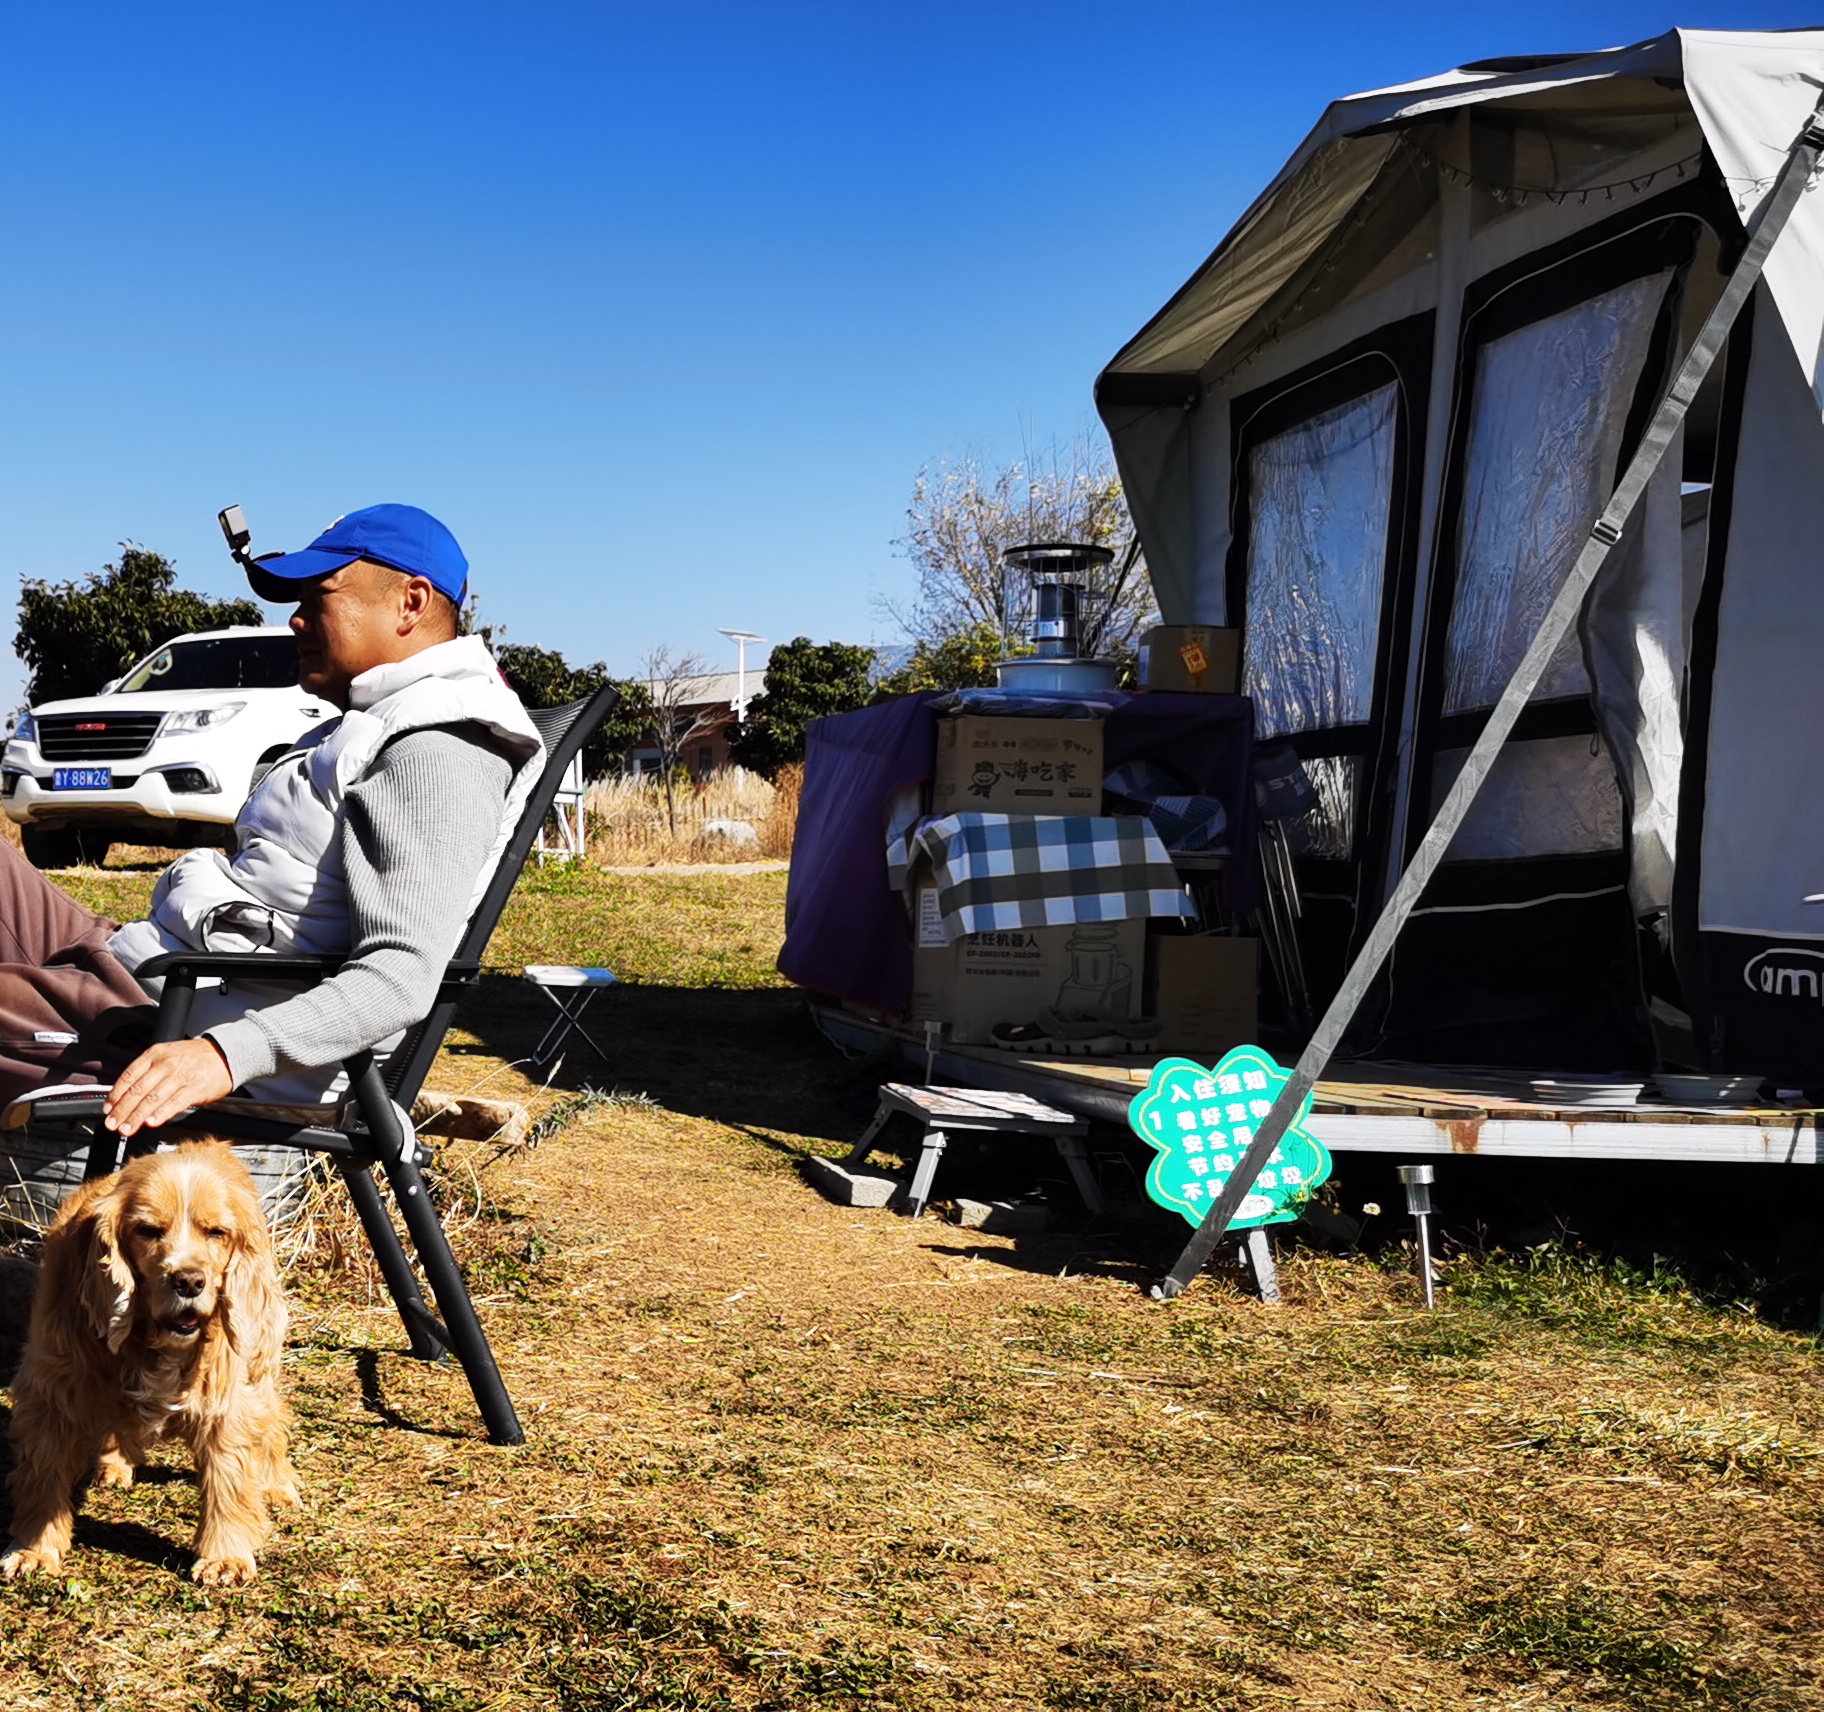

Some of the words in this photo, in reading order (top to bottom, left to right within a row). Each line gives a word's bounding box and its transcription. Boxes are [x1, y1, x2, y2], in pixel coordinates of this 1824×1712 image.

[966, 932, 1039, 947] 烹饪机器人
[1743, 947, 1824, 1007] Cam
[1170, 1070, 1268, 1103] 入住须知
[1176, 1098, 1273, 1131] 看好宠物
[1181, 1125, 1261, 1155] 安全用
[1181, 1165, 1303, 1202] 不乱垃圾
